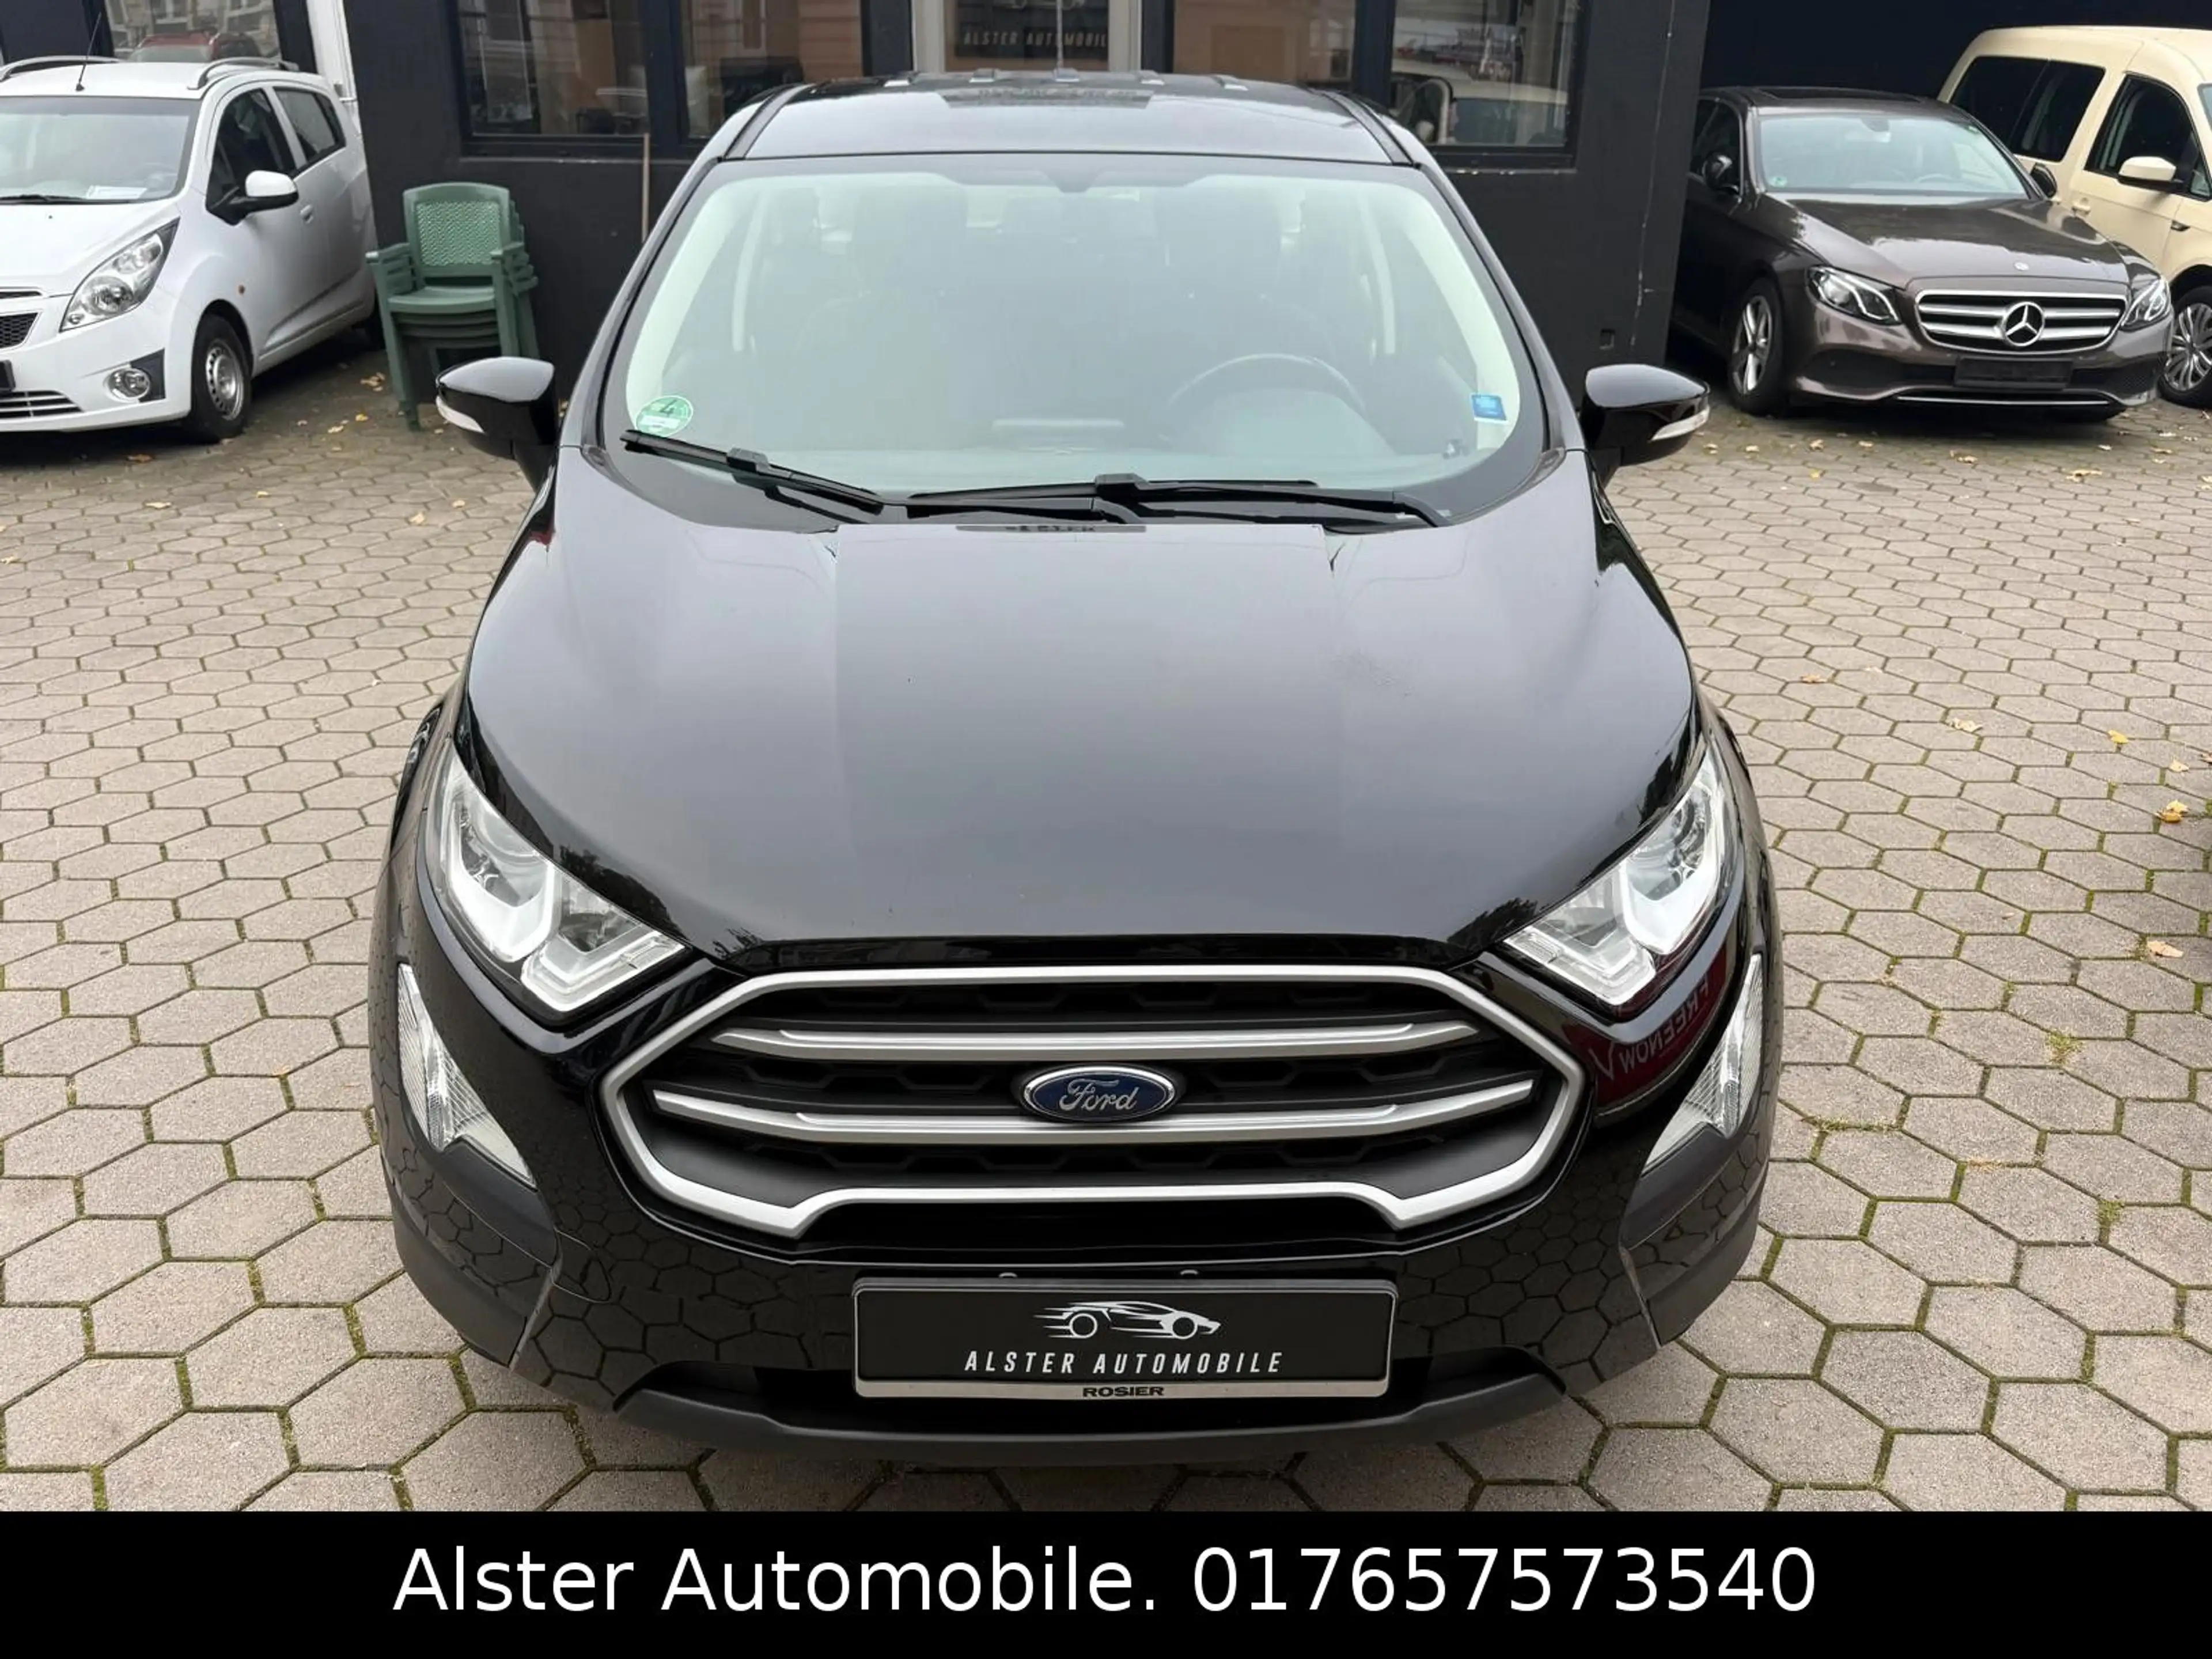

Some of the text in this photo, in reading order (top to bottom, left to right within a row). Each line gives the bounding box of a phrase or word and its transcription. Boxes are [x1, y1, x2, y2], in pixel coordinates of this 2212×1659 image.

[964, 31, 1018, 46] ALSTER
[658, 399, 677, 418] 4
[1059, 1078, 1140, 1111] Ford
[964, 1350, 1283, 1374] ALSTER AUTOMOBILE
[1082, 1385, 1165, 1397] ROSIER
